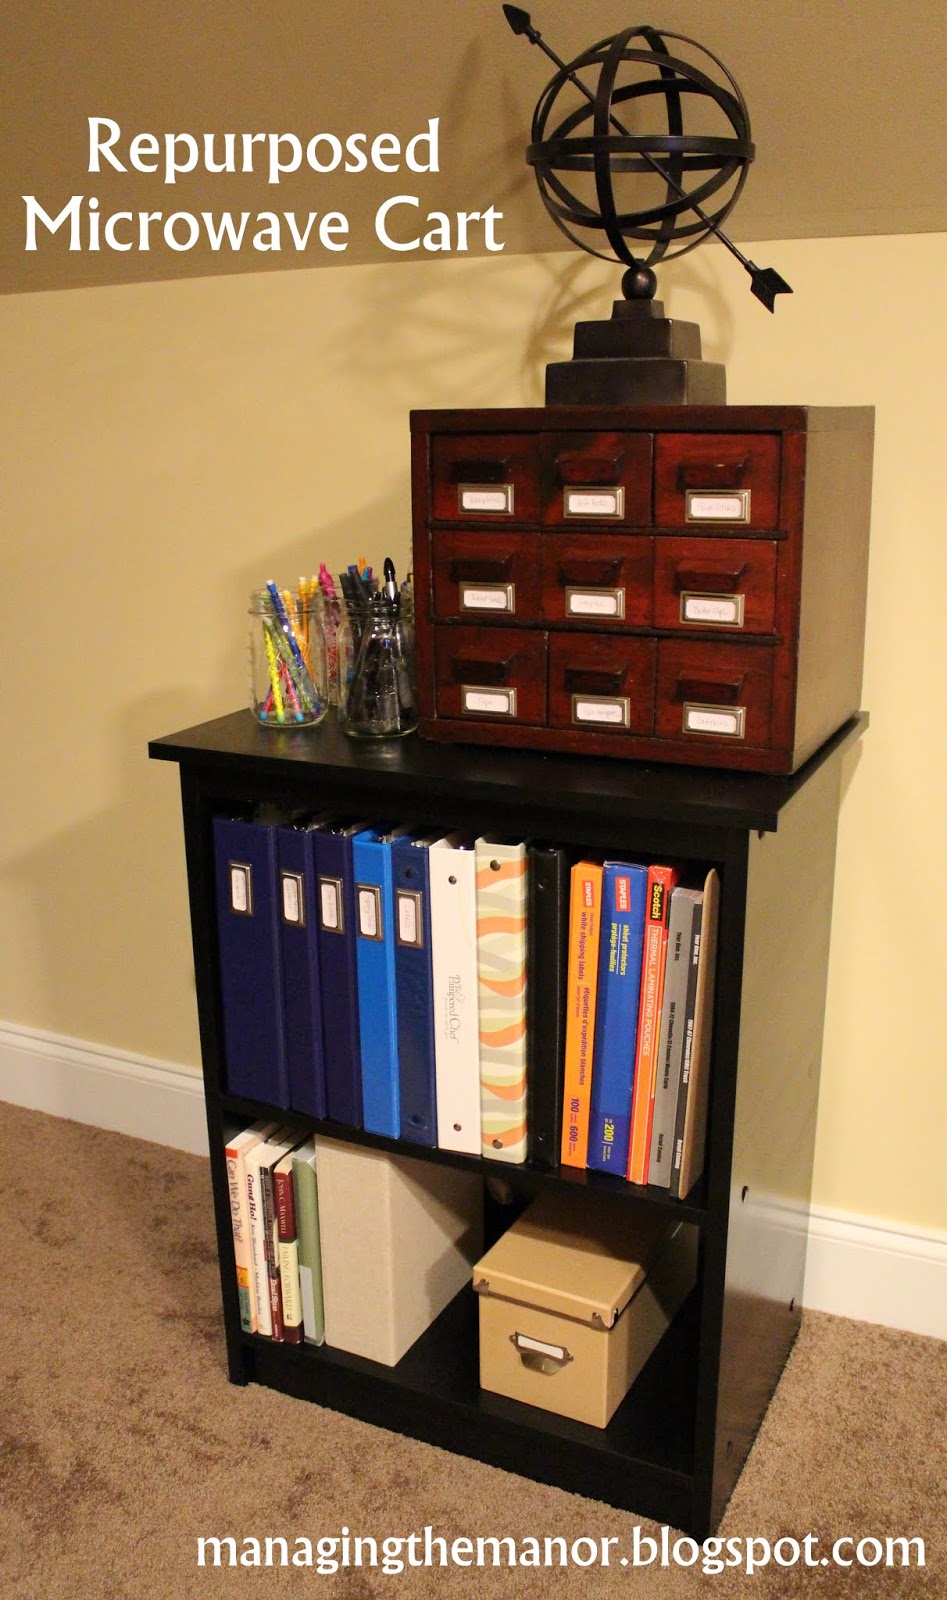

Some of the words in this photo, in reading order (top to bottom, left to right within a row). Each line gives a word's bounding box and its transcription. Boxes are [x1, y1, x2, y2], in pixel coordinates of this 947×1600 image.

[584, 881, 593, 907] STAPLES
[619, 879, 628, 910] STAPLES
[651, 884, 663, 920] Scotch
[580, 911, 588, 930] white
[622, 924, 631, 942] sheet
[578, 932, 587, 959] shipping
[609, 922, 619, 973] protège-feuilles
[649, 928, 660, 966] THERMAL
[577, 960, 586, 980] labels
[619, 943, 629, 976] protectors
[447, 975, 461, 1016] Pampered
[582, 987, 591, 1018] étiquettes
[645, 968, 657, 1018] LAMINATING
[450, 1018, 461, 1040] Chef
[580, 1019, 590, 1057] d'expédition
[642, 1019, 652, 1058] POUCHES
[579, 1058, 588, 1086] blanches
[570, 1098, 580, 1113] 100
[569, 1126, 579, 1142] 600
[604, 1123, 615, 1142] 200
[228, 1160, 236, 1179] Can
[230, 1182, 238, 1199] We
[247, 1174, 255, 1201] Gung
[276, 1179, 285, 1196] JOHN
[231, 1200, 240, 1216] Do
[249, 1202, 257, 1221] Ho!
[279, 1205, 288, 1234] MAXWELL
[232, 1218, 243, 1243] That?
[282, 1246, 290, 1272] FAILING
[283, 1274, 293, 1311] FORWARD
